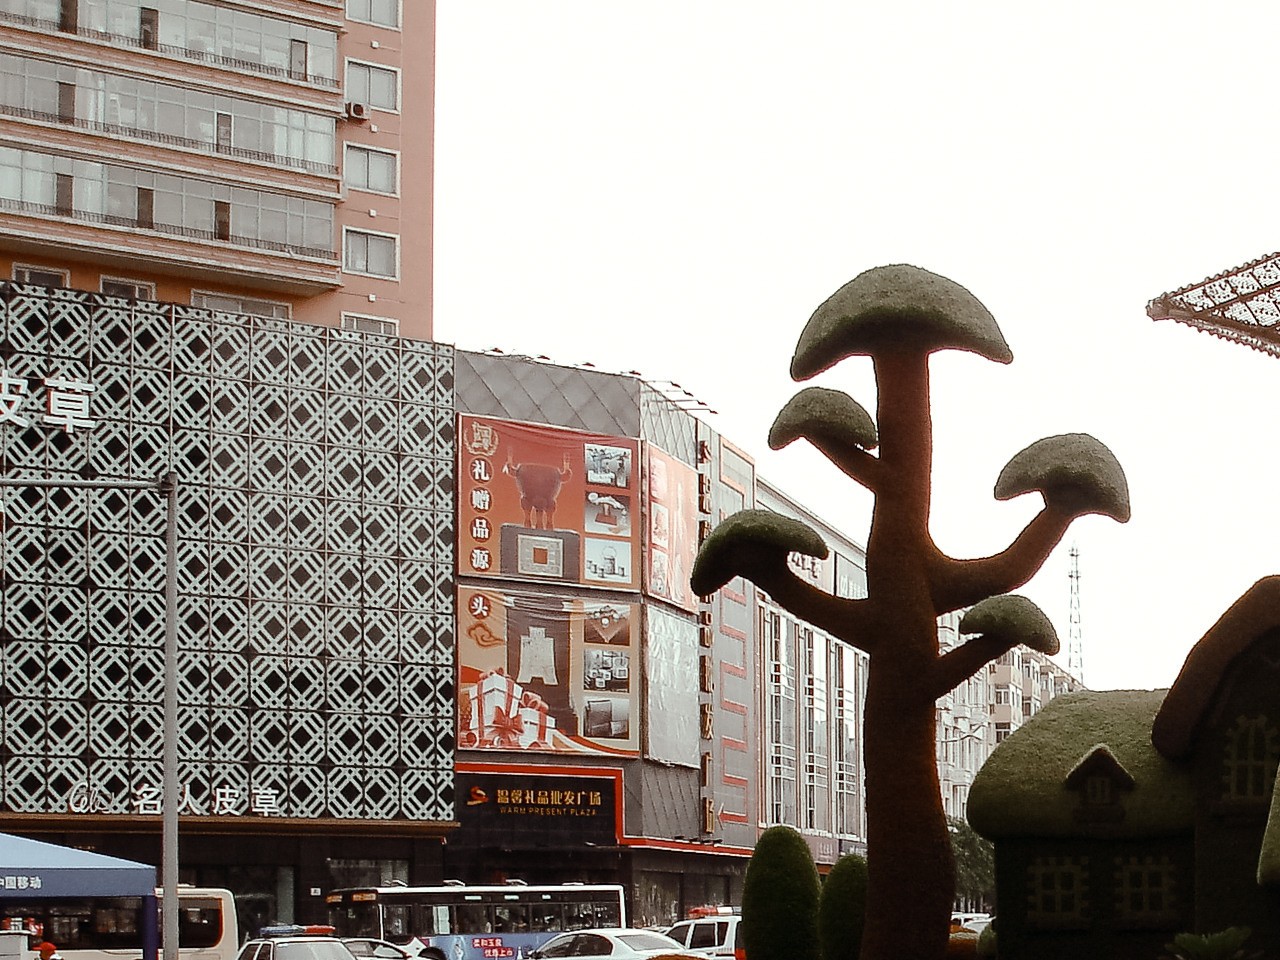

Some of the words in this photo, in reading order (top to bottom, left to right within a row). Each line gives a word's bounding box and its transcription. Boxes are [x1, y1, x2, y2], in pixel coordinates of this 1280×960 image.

[0, 370, 96, 434] 皮草
[131, 783, 280, 817] 名人皮草
[496, 788, 601, 806] 温馨礼品批发广场
[500, 806, 526, 814] WARM
[528, 807, 567, 816] PRESENT
[570, 808, 597, 817] PLAZA
